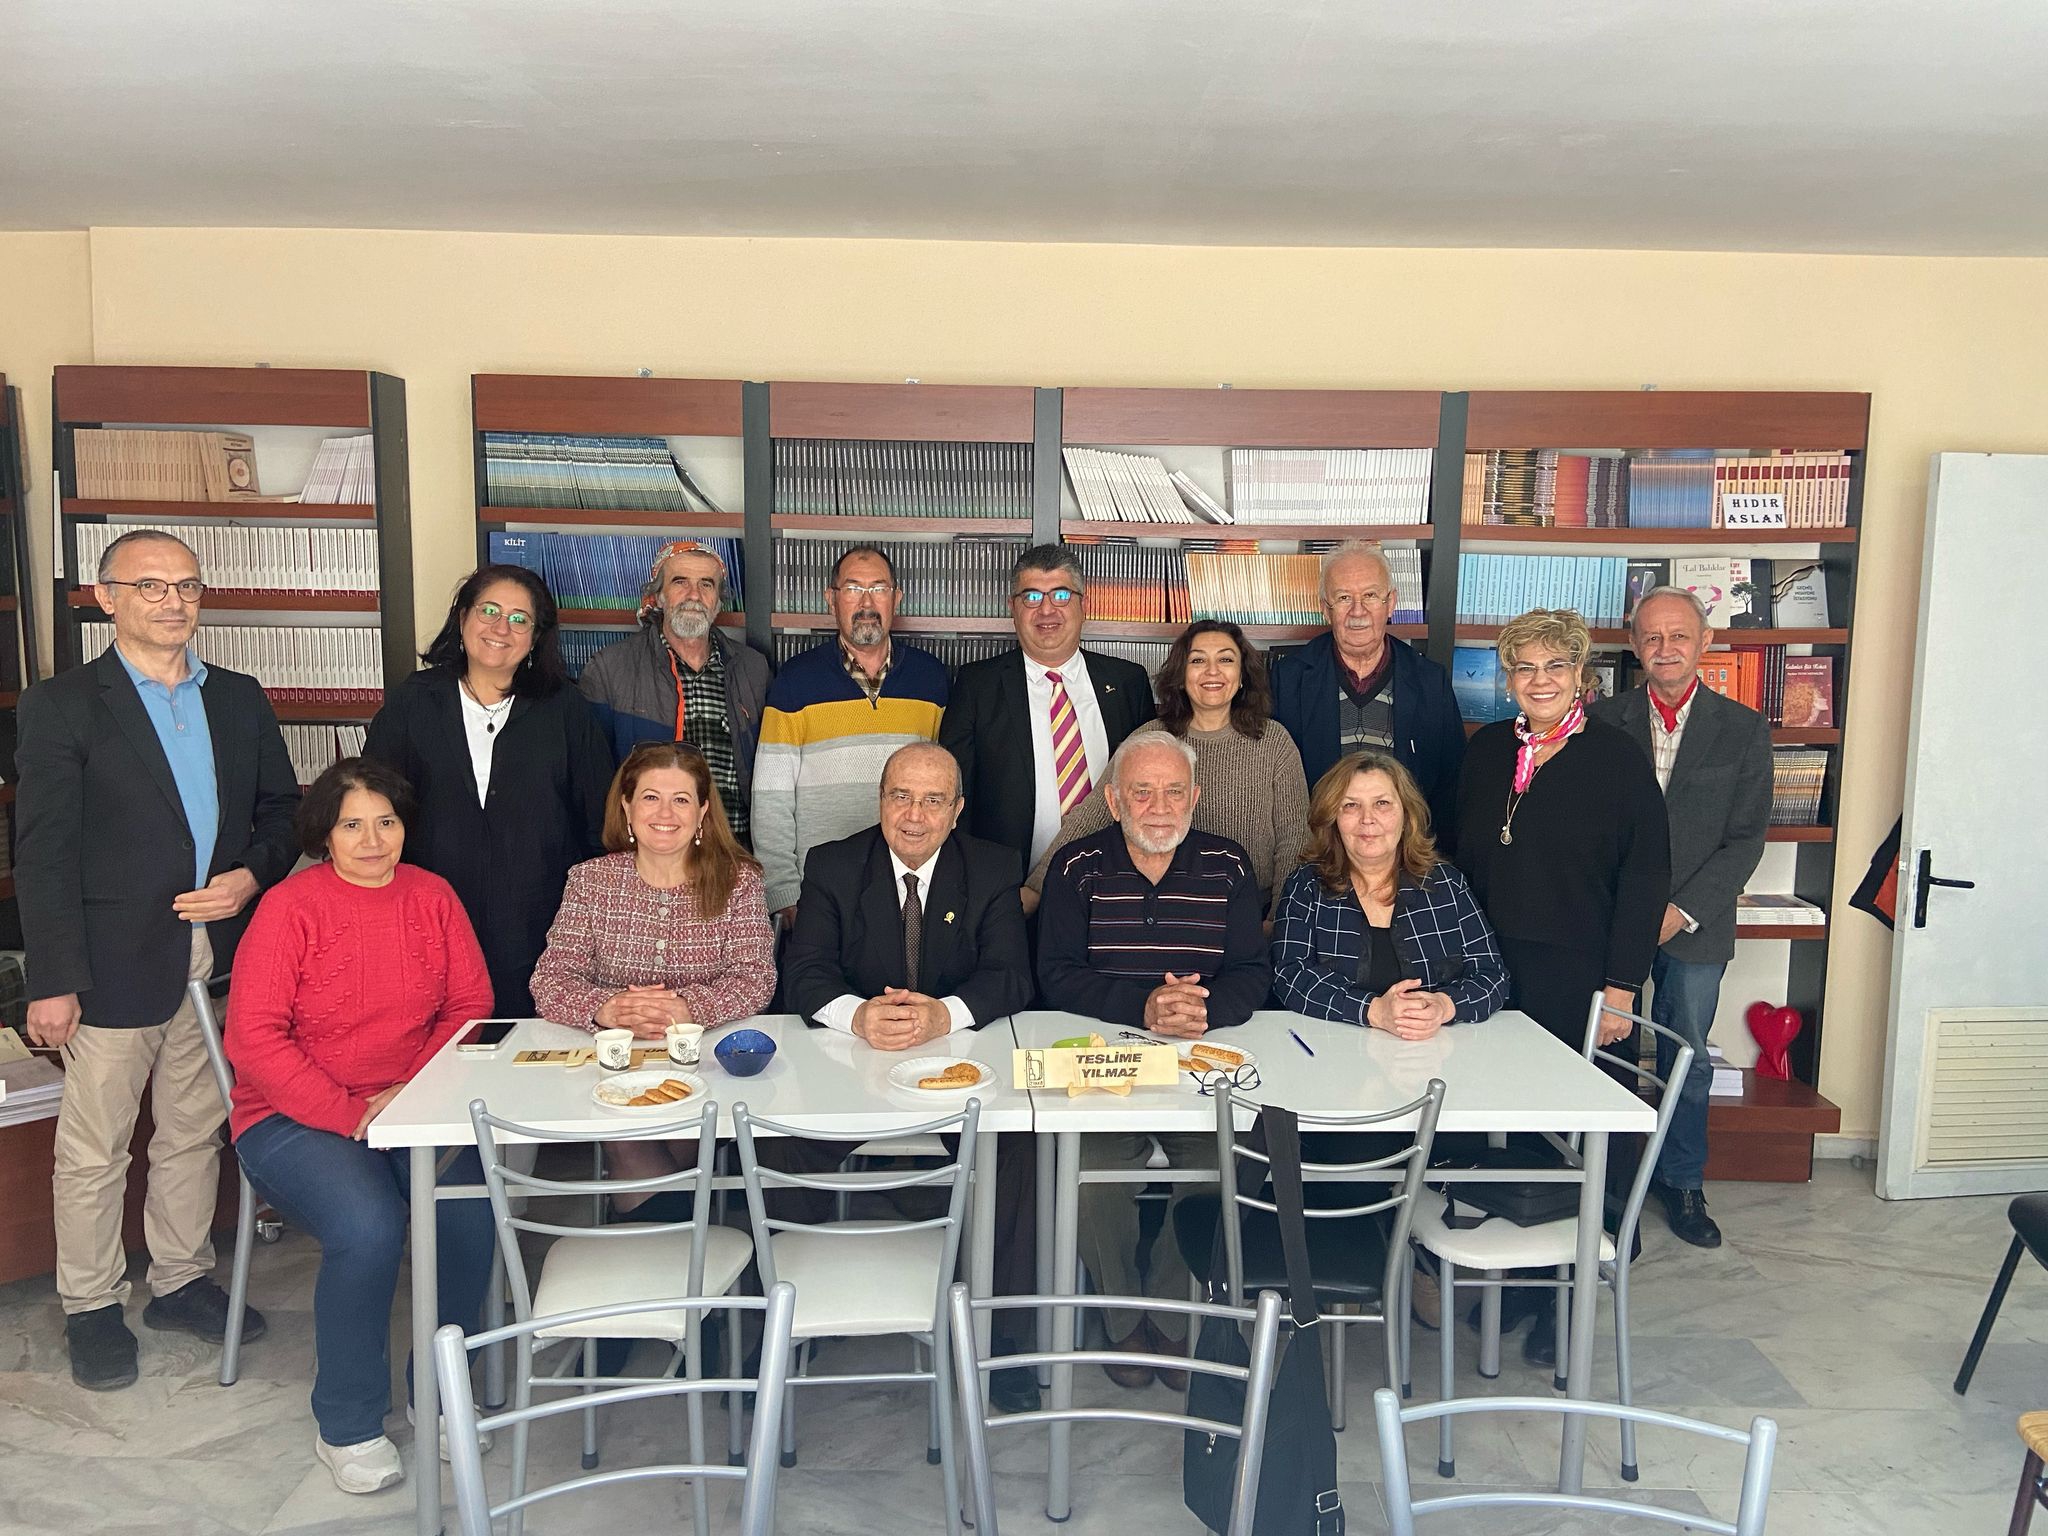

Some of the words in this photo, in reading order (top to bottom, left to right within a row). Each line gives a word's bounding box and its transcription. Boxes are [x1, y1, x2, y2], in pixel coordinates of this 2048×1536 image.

[1732, 498, 1780, 508] HIDIR
[1727, 514, 1784, 524] ASLAN
[504, 537, 526, 547] KİLİT
[1682, 564, 1697, 572] Lal
[1699, 563, 1726, 572] Balıklar
[1075, 1051, 1143, 1064] TESLİME
[1081, 1067, 1139, 1078] YILMAZ
